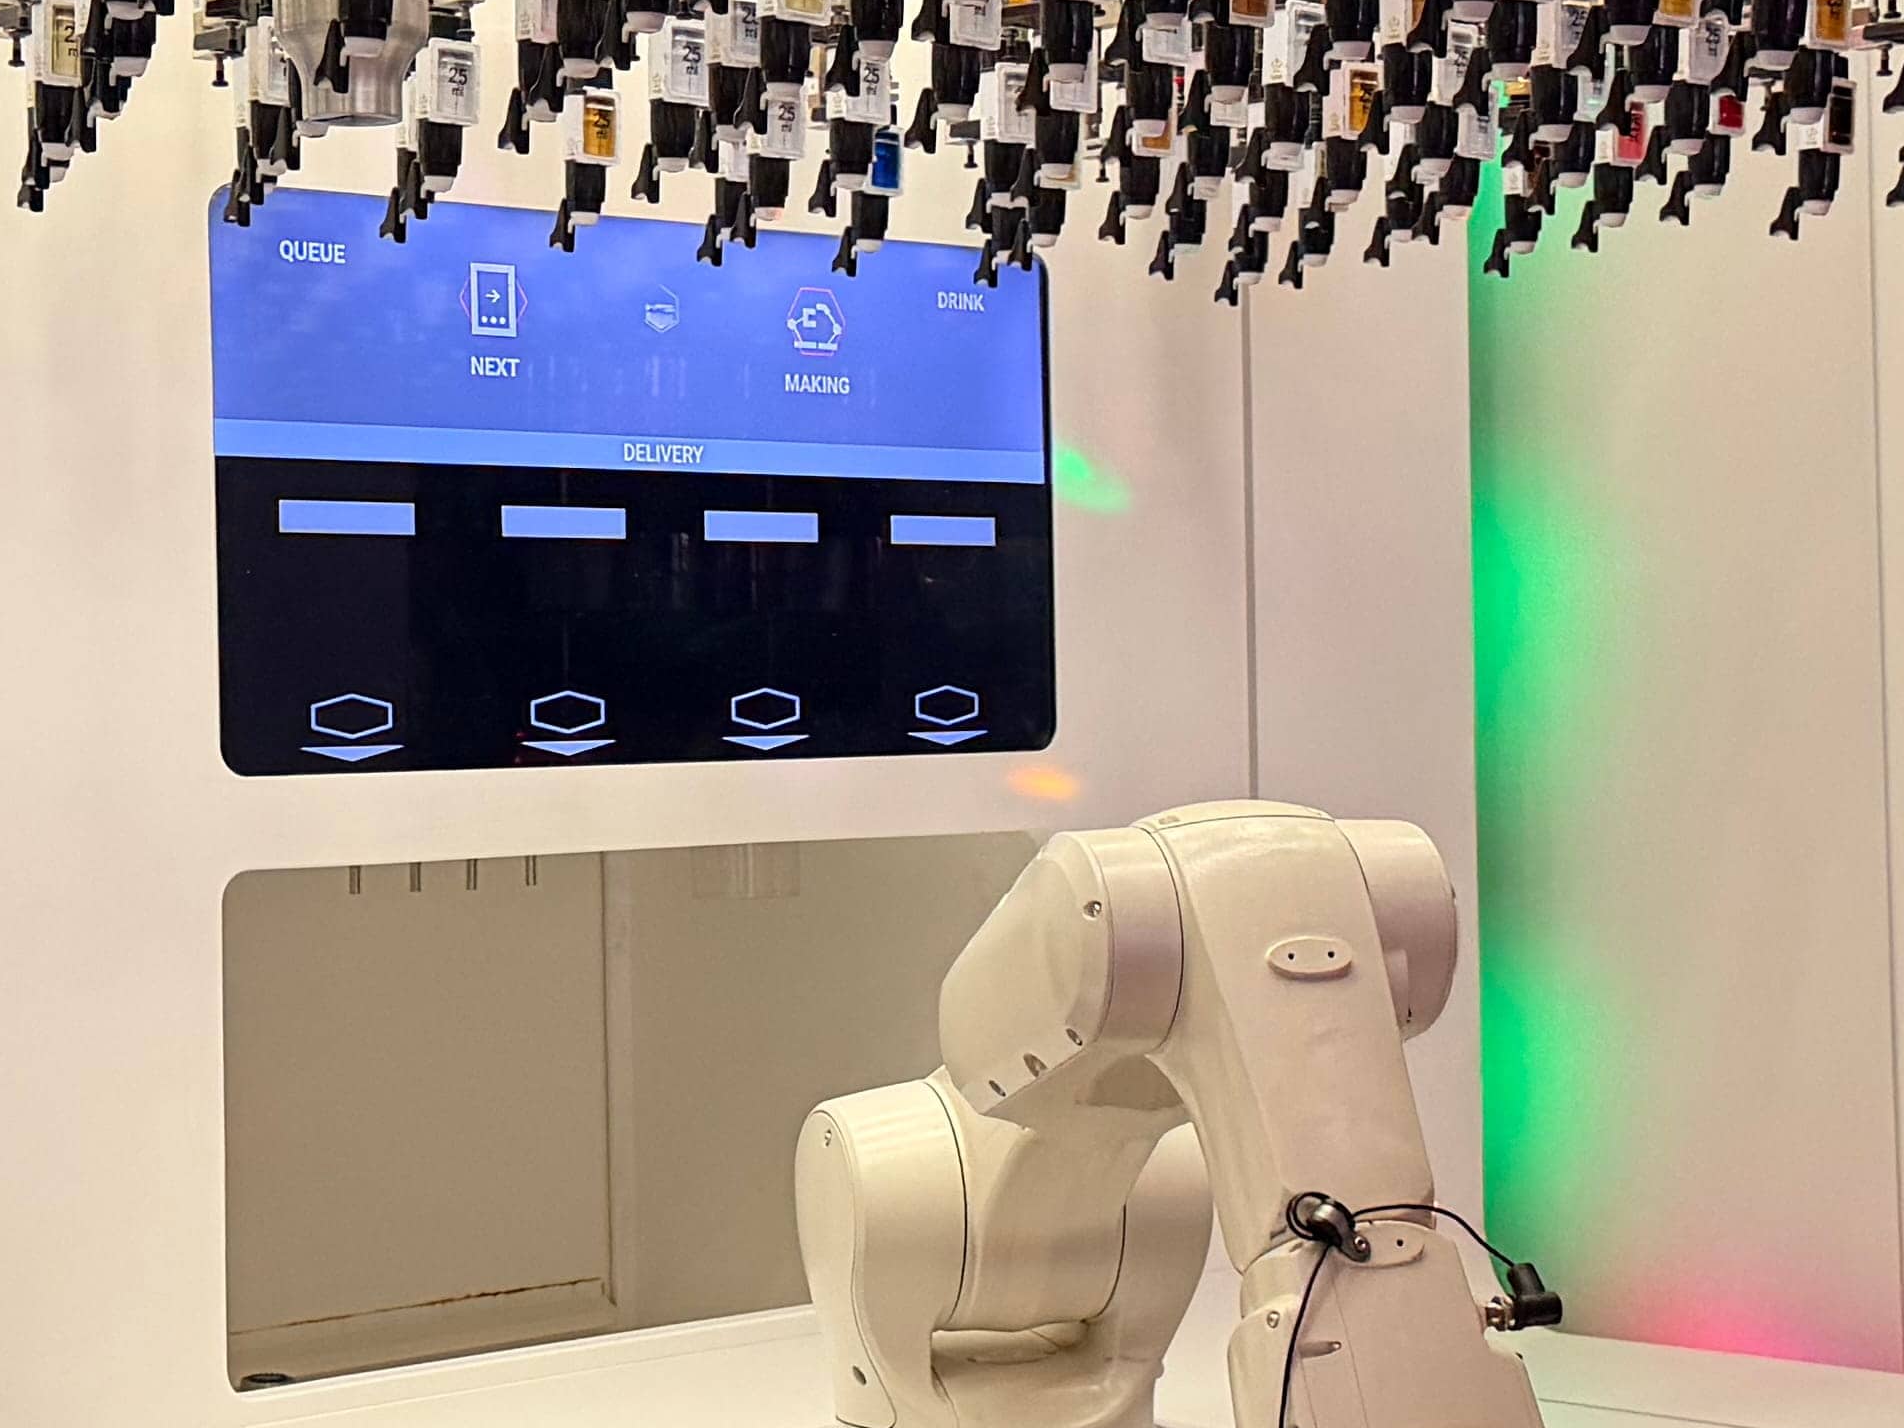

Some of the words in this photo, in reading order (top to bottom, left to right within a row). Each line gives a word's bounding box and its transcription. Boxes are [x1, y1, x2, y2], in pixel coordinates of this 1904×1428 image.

[448, 68, 468, 86] 25
[279, 240, 346, 265] QUEUE
[937, 290, 985, 312] DRINK
[469, 356, 520, 377] NEXT
[784, 373, 851, 395] MAKING
[623, 442, 704, 465] DELIVERY
